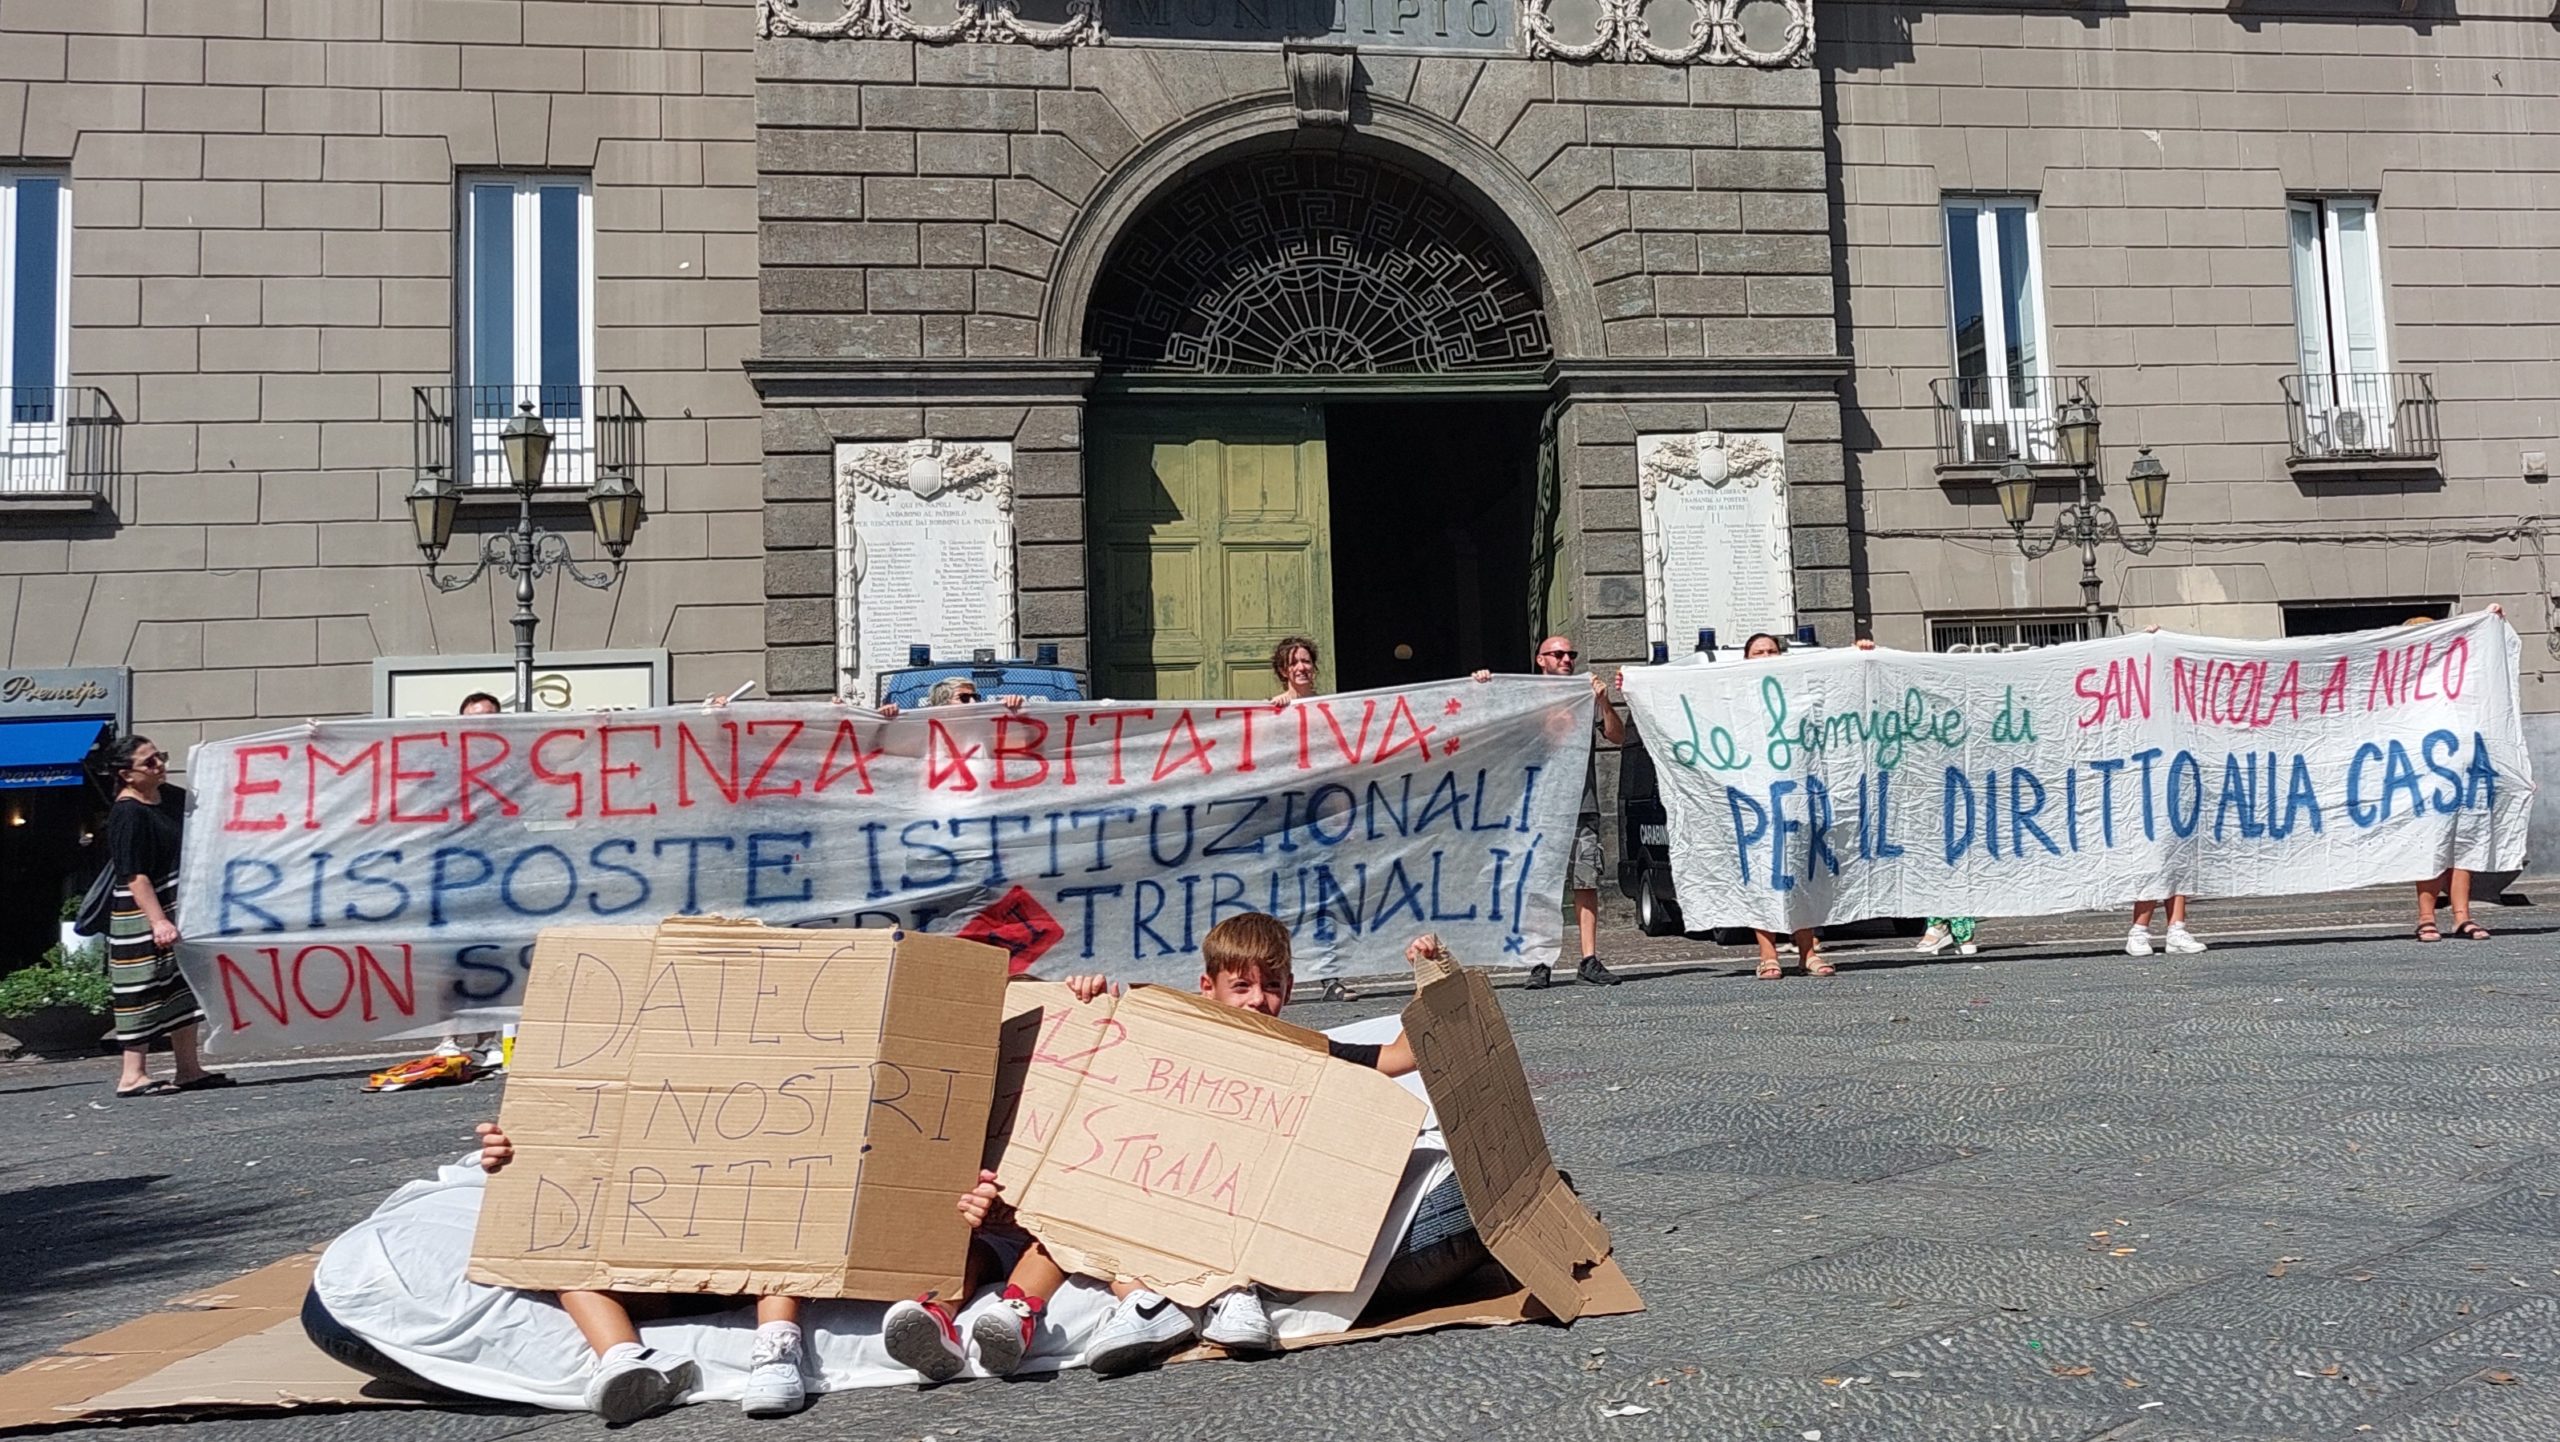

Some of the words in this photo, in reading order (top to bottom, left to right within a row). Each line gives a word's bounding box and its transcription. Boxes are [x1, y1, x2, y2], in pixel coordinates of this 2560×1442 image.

[1130, 0, 1497, 37] MUNICIPIO
[1762, 675, 1972, 771] famiglie
[1992, 685, 2040, 744] di
[2075, 653, 2152, 729] SAN
[2174, 656, 2299, 729] NICOLA
[2320, 656, 2349, 715] A
[2367, 636, 2469, 712] NILO
[224, 719, 884, 831] EMERGENZA
[1727, 774, 1840, 892] PER
[1859, 770, 1904, 861] IL
[1944, 747, 2200, 866] DIRITTO
[2214, 750, 2322, 842] ALLA
[2347, 729, 2499, 828] CASA
[220, 831, 813, 935] RISPOSTE
[859, 766, 1541, 900] ISTITUZIONALI
[218, 943, 414, 1032] NON
[577, 1082, 609, 1140] I
[643, 1061, 961, 1143] NOSTRI
[1006, 1007, 1128, 1085] 12
[1140, 1057, 1311, 1138] BAMBINI
[1061, 1104, 1242, 1217] STRADA
